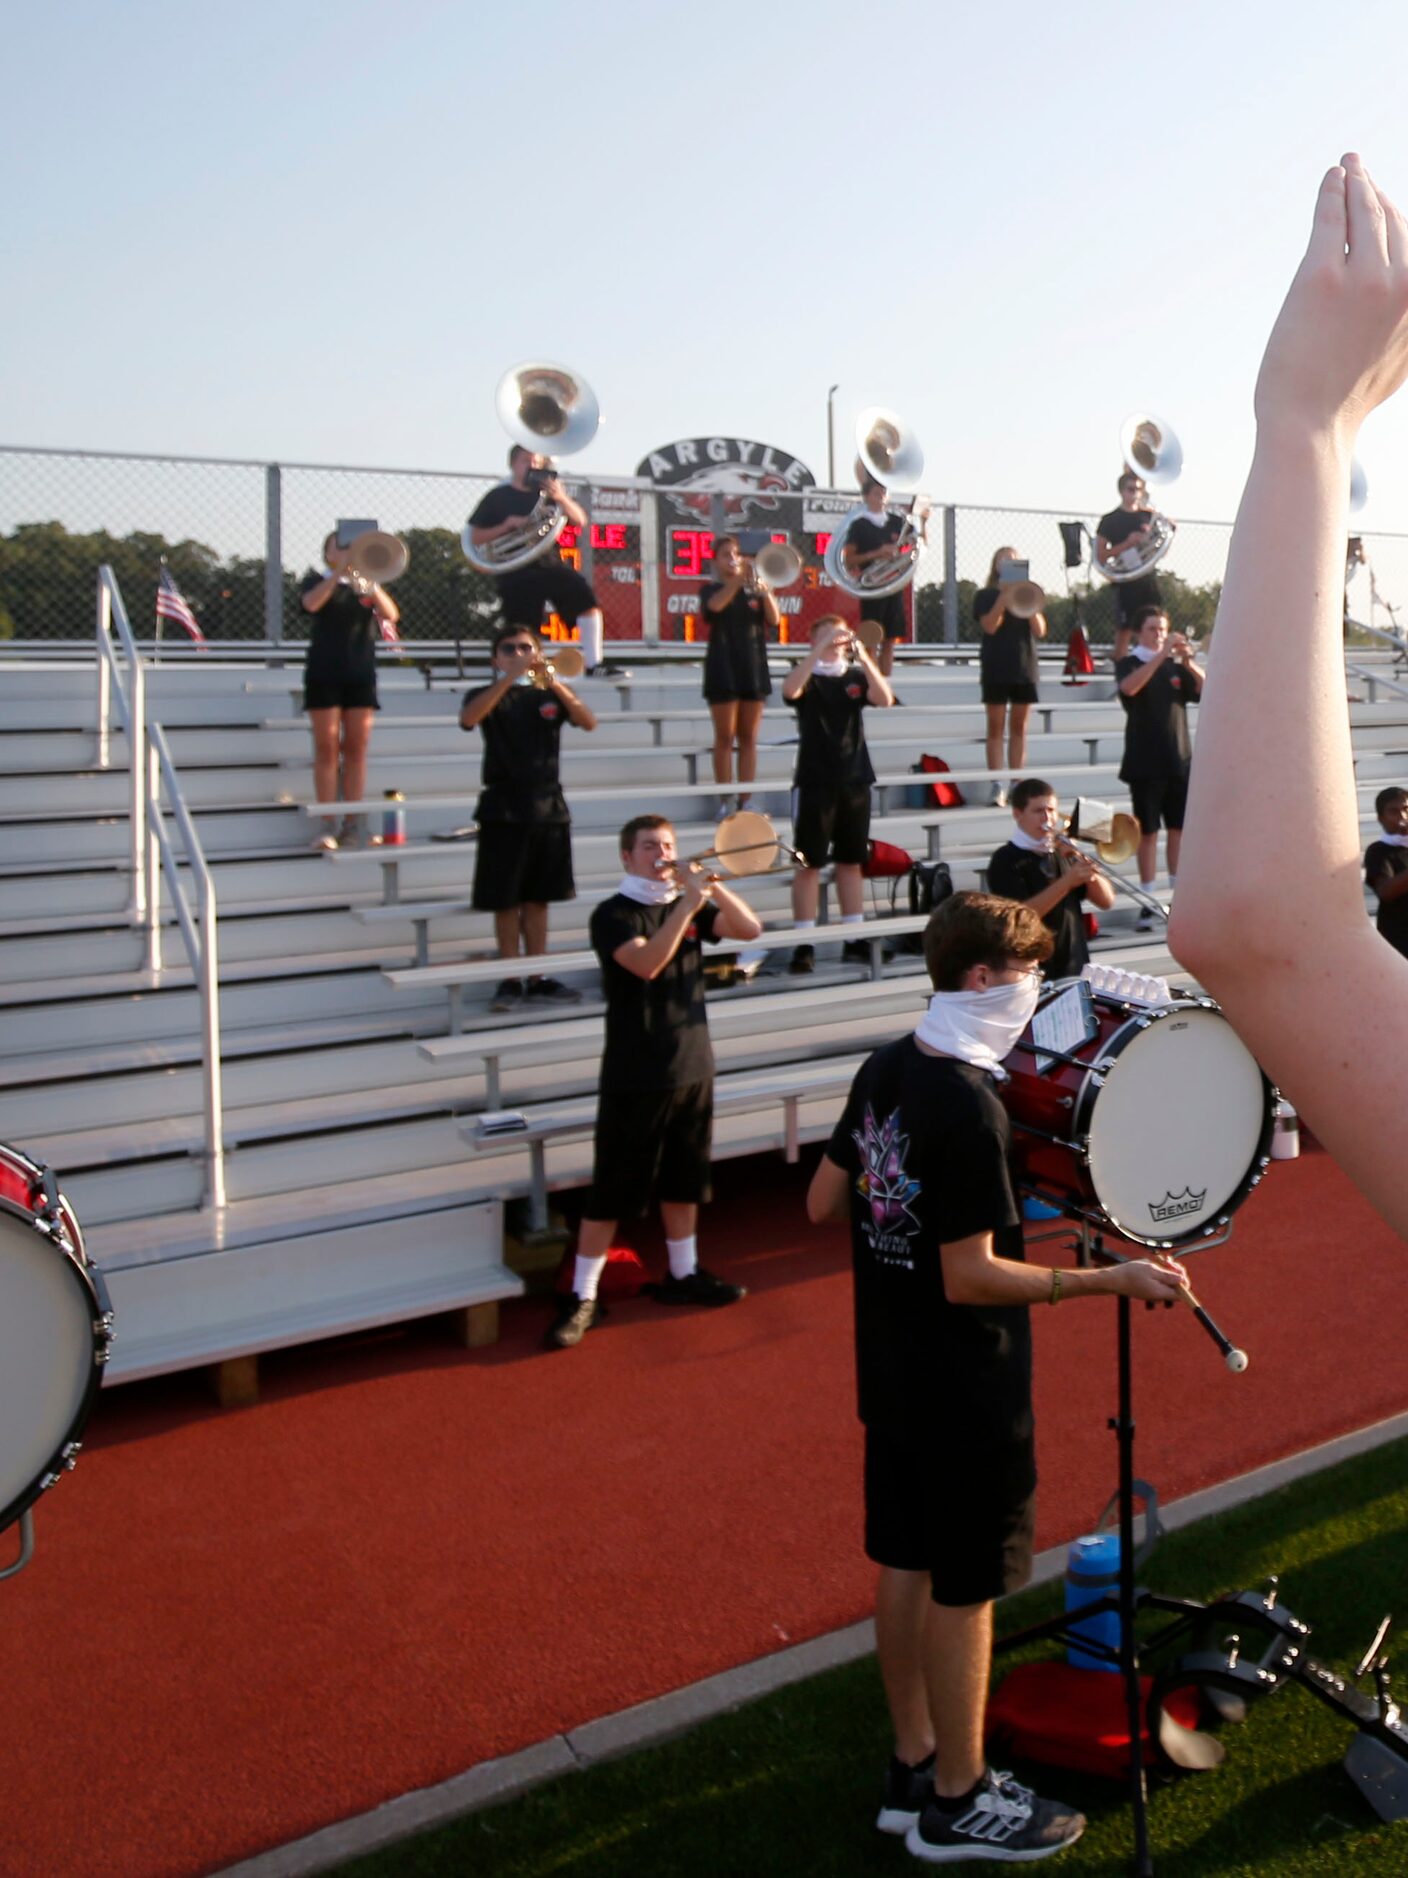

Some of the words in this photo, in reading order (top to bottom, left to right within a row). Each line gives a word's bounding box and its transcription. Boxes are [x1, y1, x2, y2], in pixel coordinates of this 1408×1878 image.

[648, 437, 808, 487] ARGYLE
[666, 594, 699, 613] QTR
[776, 595, 803, 613] WN
[1156, 1198, 1200, 1218] REMO
